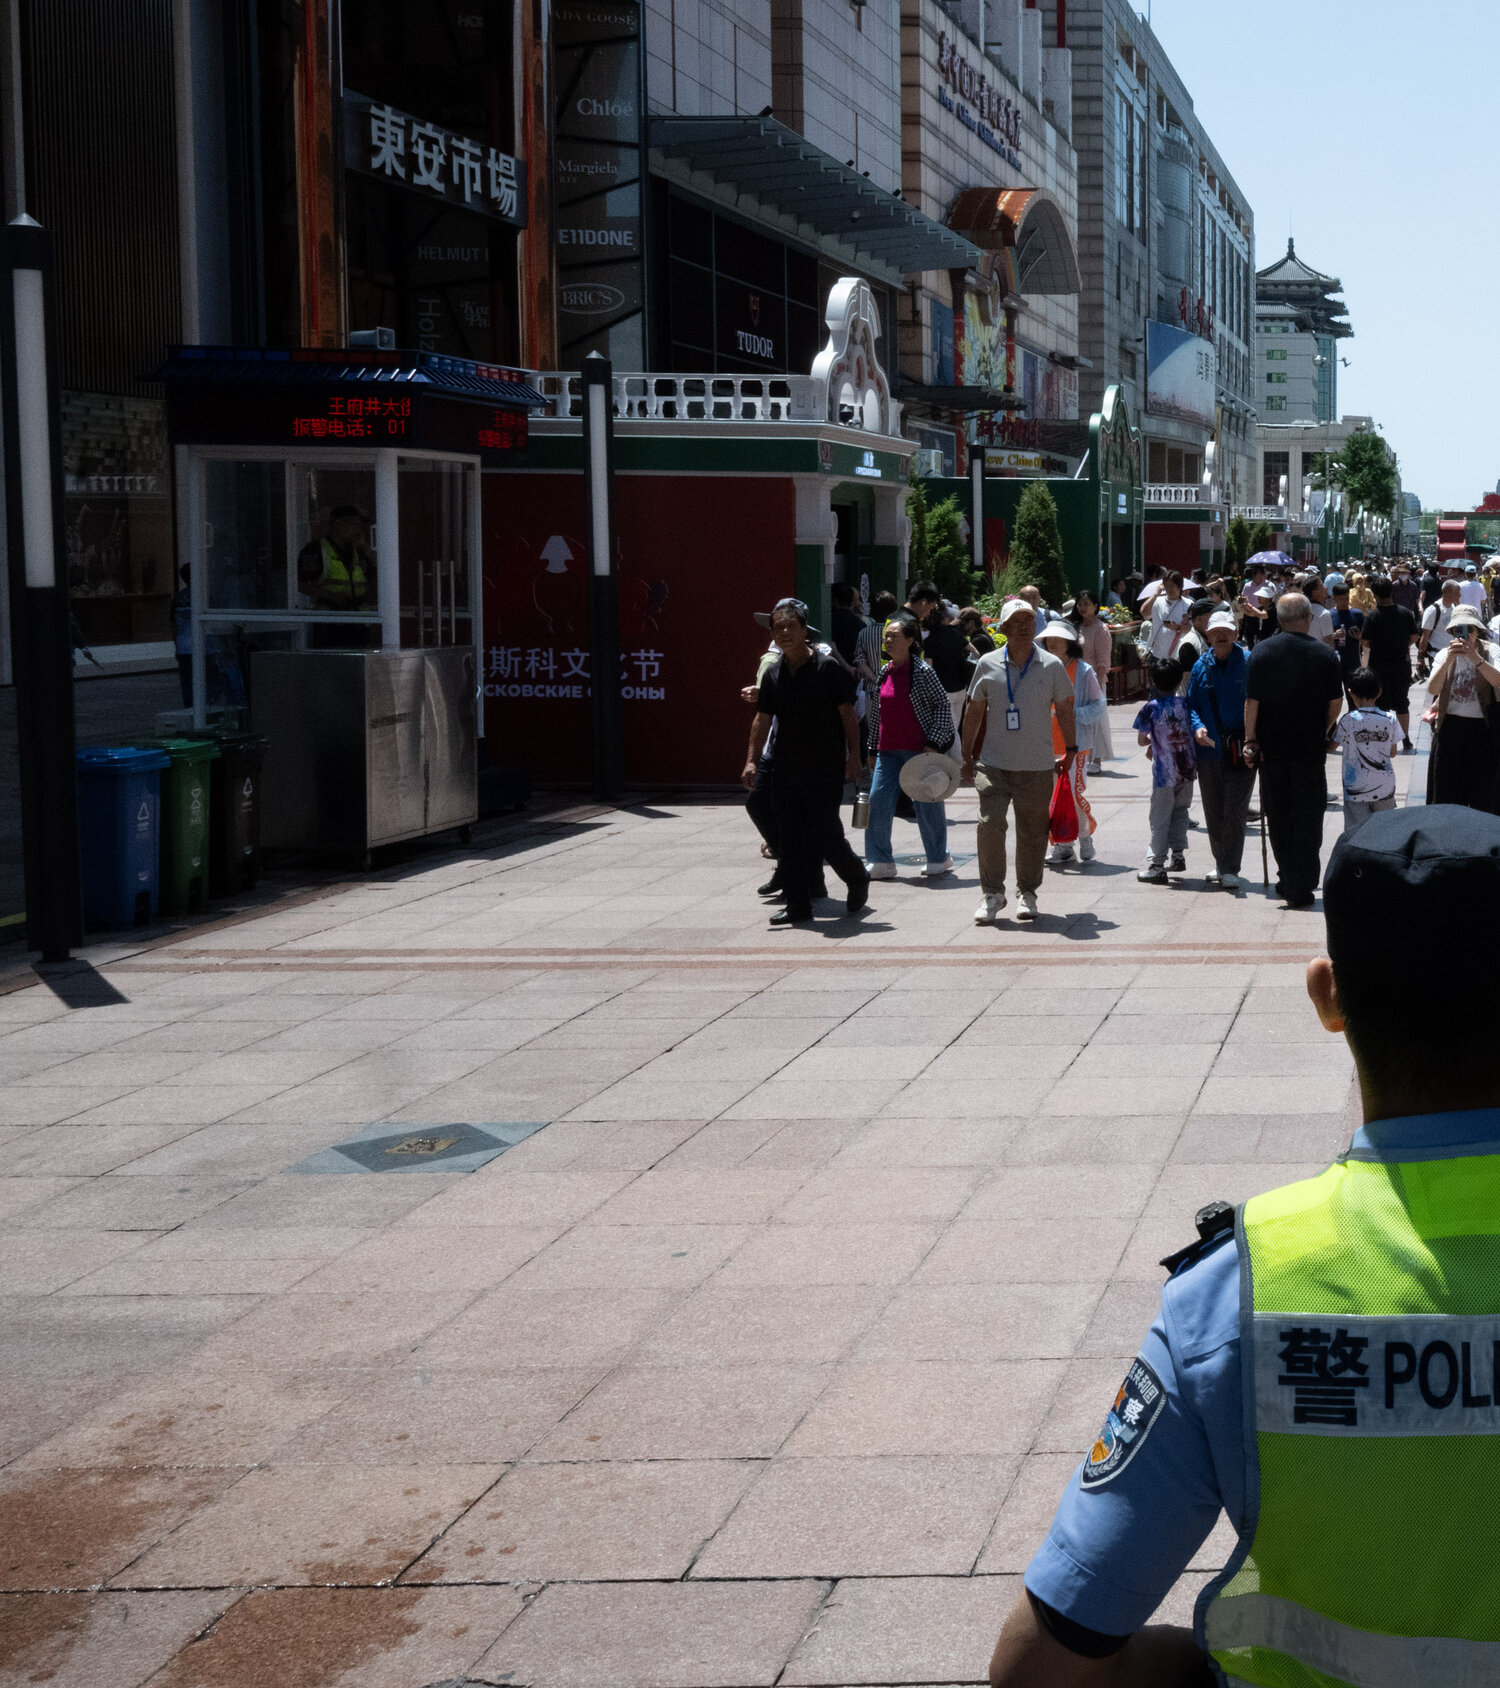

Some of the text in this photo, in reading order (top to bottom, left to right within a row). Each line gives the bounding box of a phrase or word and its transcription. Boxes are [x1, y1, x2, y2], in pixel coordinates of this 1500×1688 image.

[370, 103, 518, 219] 東安市場
[559, 160, 618, 176] Margiela
[417, 247, 480, 261] HELMUT
[736, 330, 775, 360] TUDOR
[1277, 1327, 1370, 1427] 警
